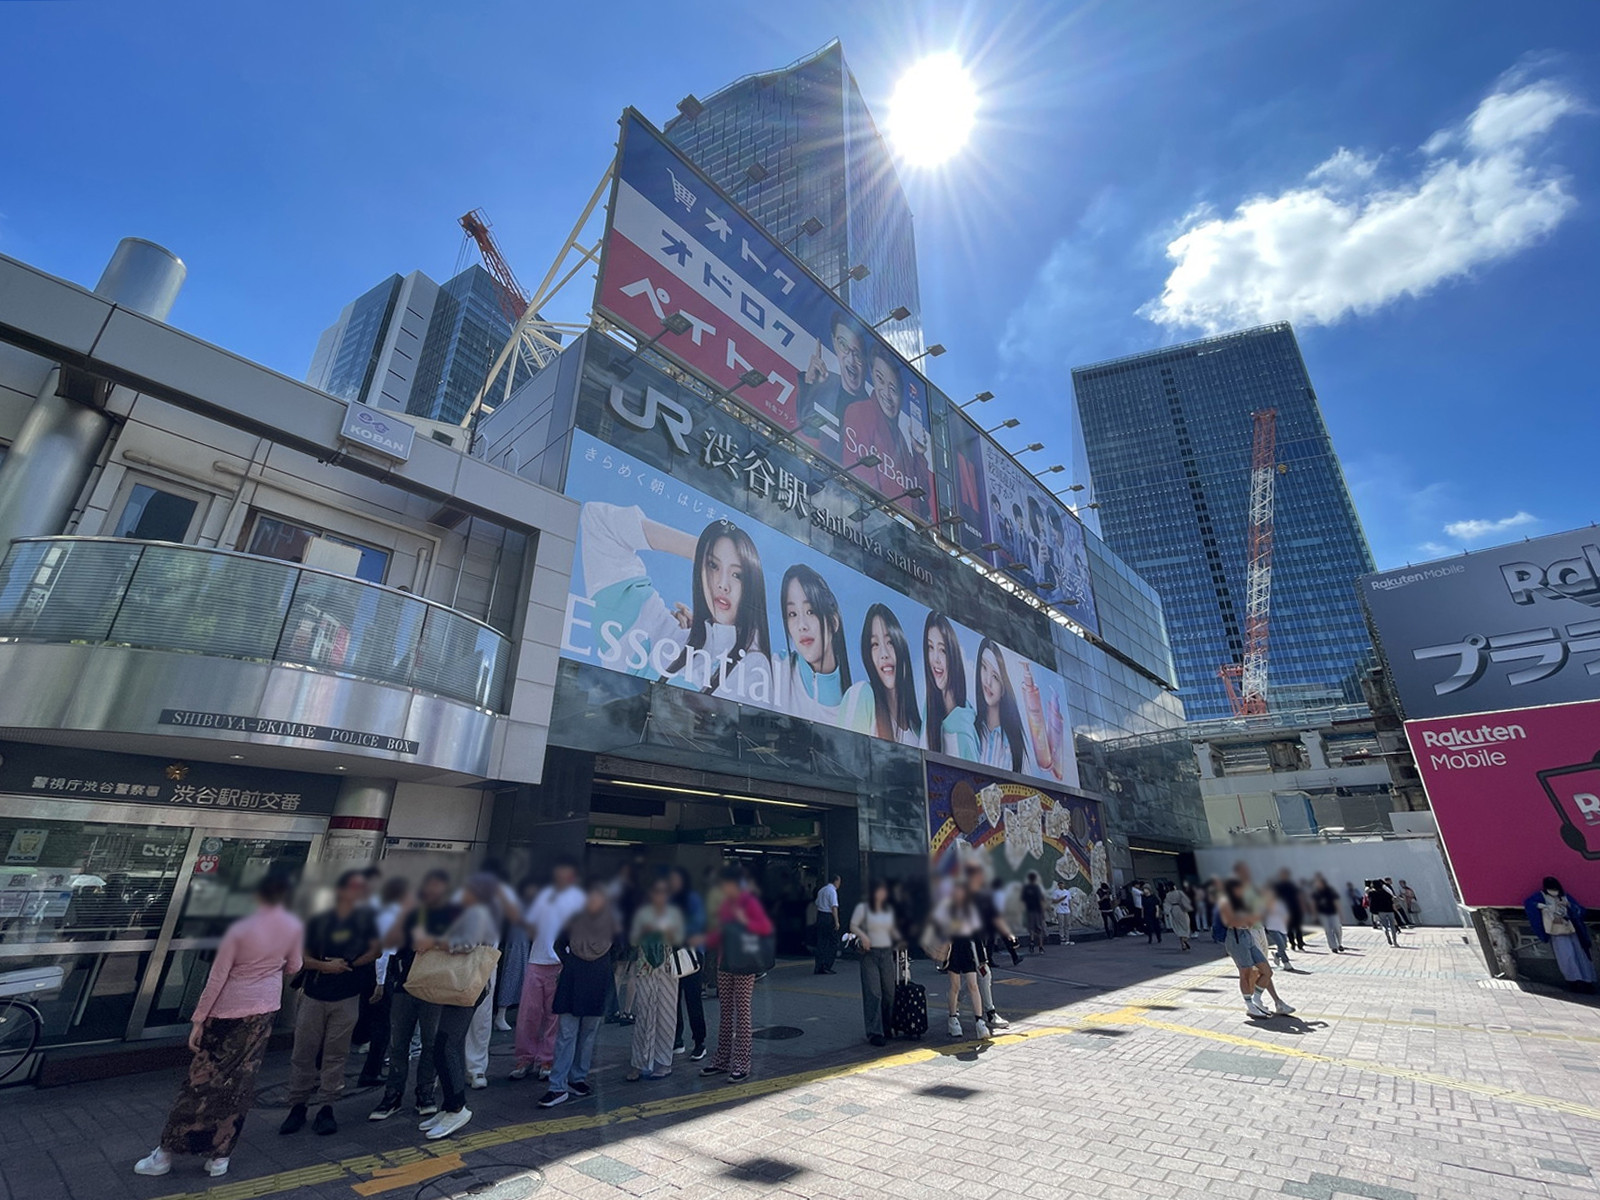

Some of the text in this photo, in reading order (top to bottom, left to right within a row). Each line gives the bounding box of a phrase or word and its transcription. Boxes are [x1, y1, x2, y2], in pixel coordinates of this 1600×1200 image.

[661, 229, 796, 347] オドロク
[705, 207, 796, 296] オトク
[619, 277, 796, 405] ペイトク
[350, 425, 404, 452] KOBAN
[610, 384, 693, 455] JR
[584, 447, 736, 532] きらめく朝、はじまる。
[703, 427, 809, 518] 渋谷駅
[816, 507, 934, 586] shibuya station
[1371, 563, 1465, 591] Rakuten Mobile
[560, 592, 783, 708] Essential
[172, 711, 412, 753] SHIBUYA-EKIMAE POLICE BOX
[1422, 724, 1527, 750] Rakuten
[1430, 749, 1507, 770] Mobile
[31, 775, 301, 811] 警視庁渋谷警察署 渋谷駅前交番
